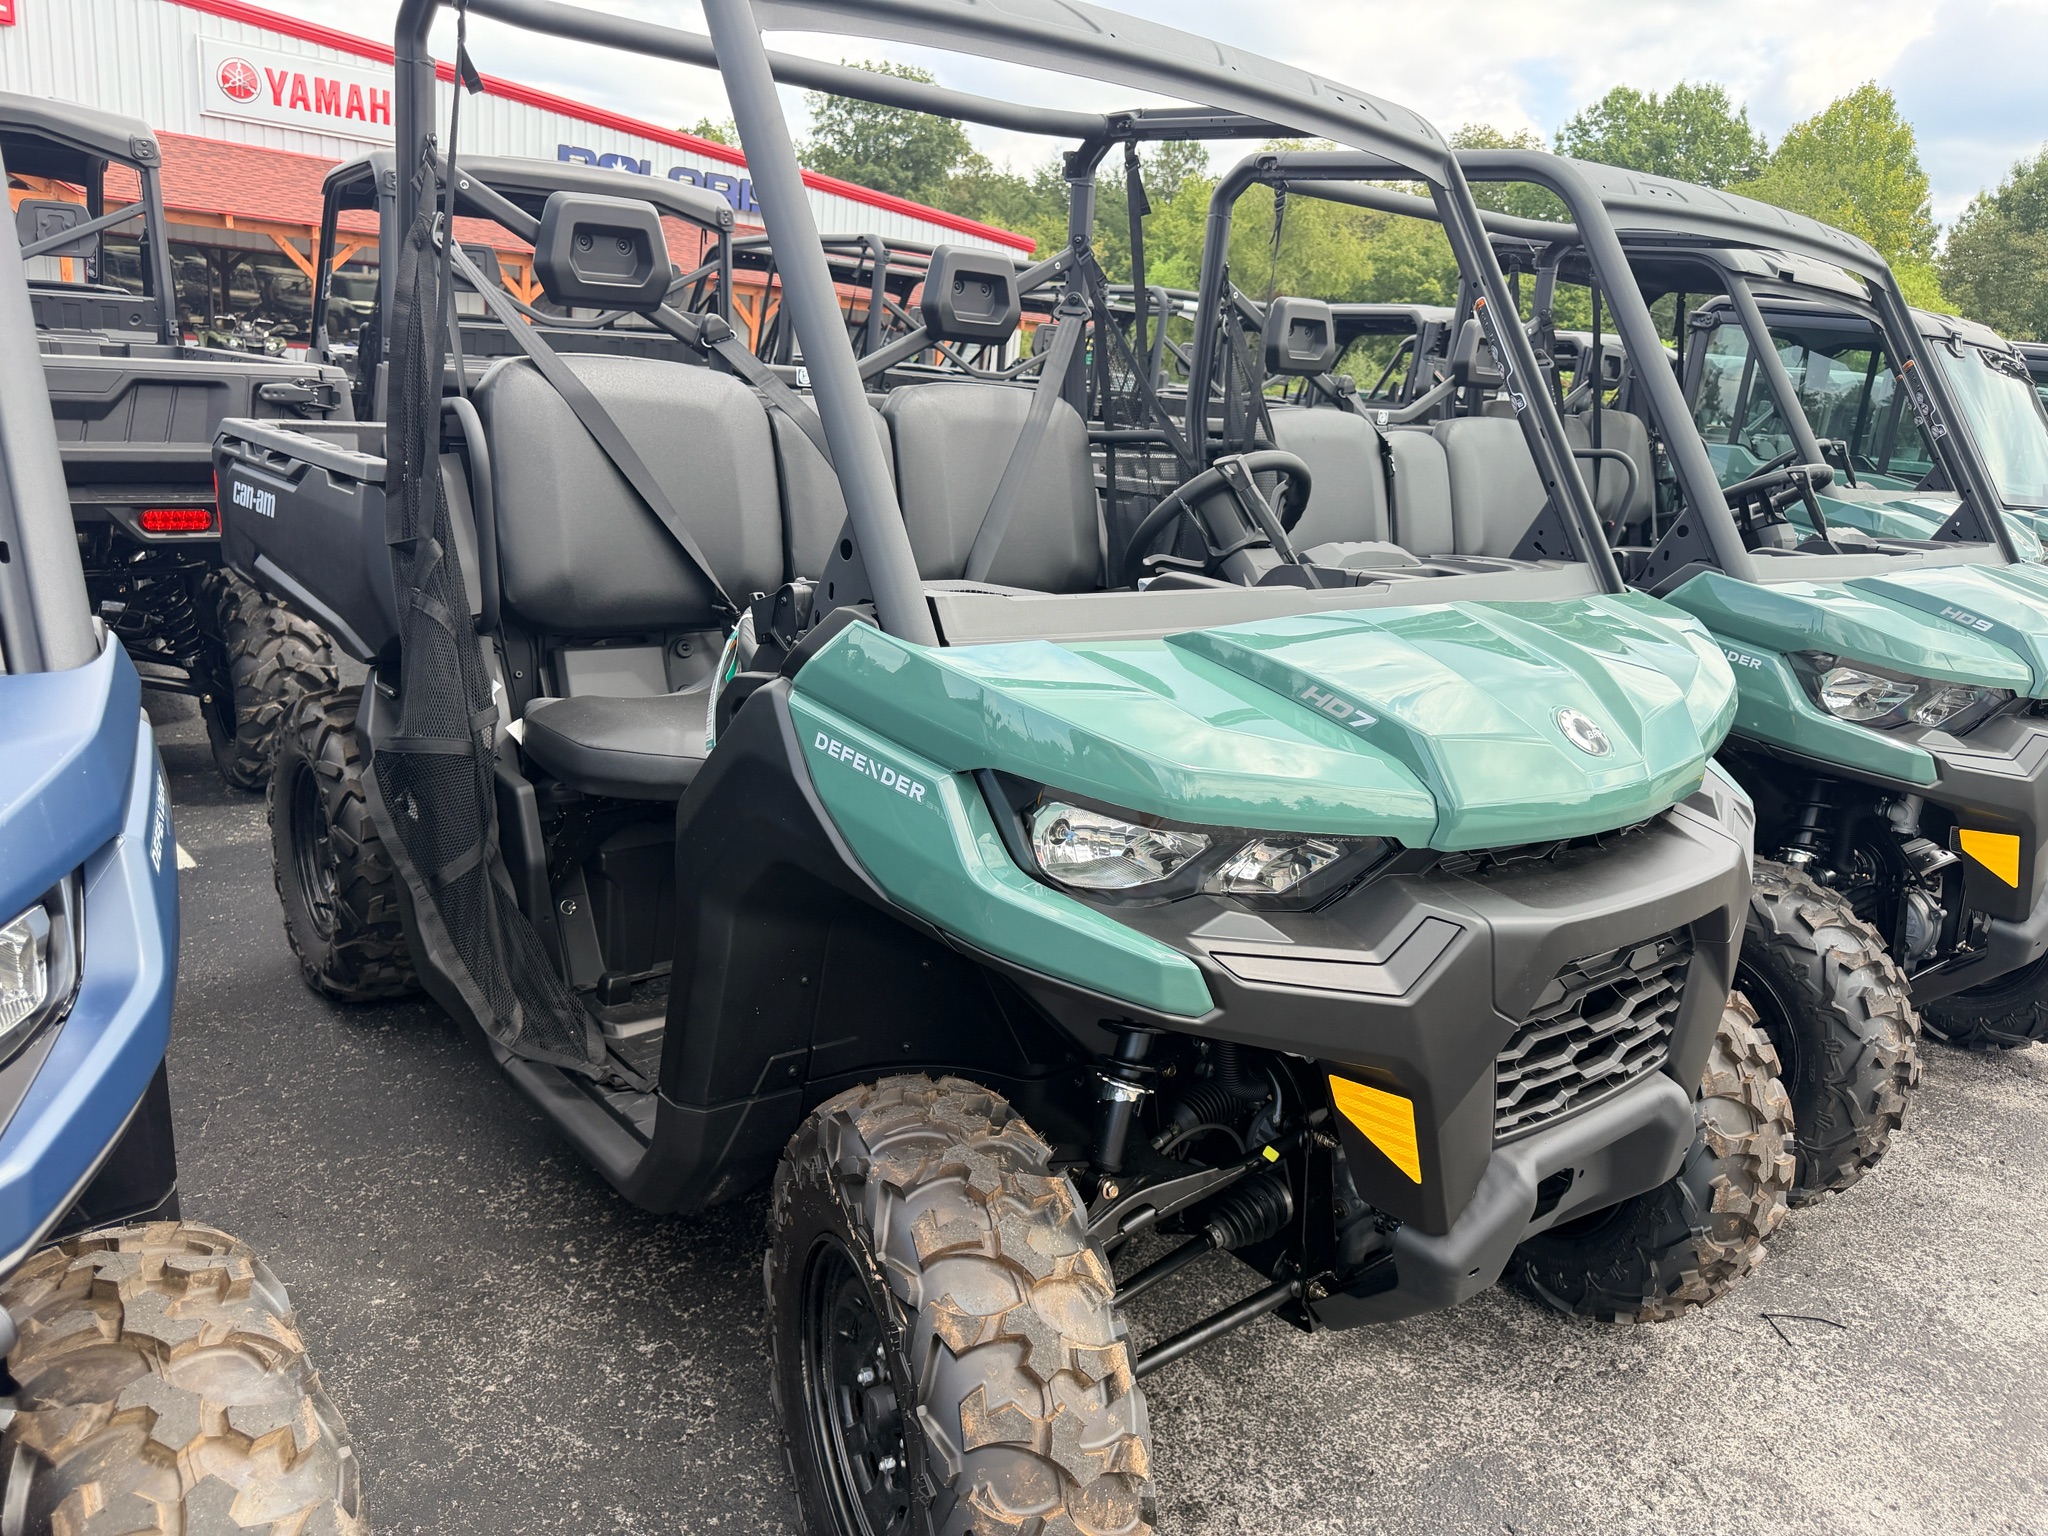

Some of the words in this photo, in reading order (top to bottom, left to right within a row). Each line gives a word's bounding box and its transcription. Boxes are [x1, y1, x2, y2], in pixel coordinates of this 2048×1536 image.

[264, 66, 396, 126] YAMAH
[1940, 605, 1994, 632] HD9
[1723, 648, 1762, 670] DER
[1300, 685, 1377, 727] HD7
[814, 731, 926, 803] DEFENDER
